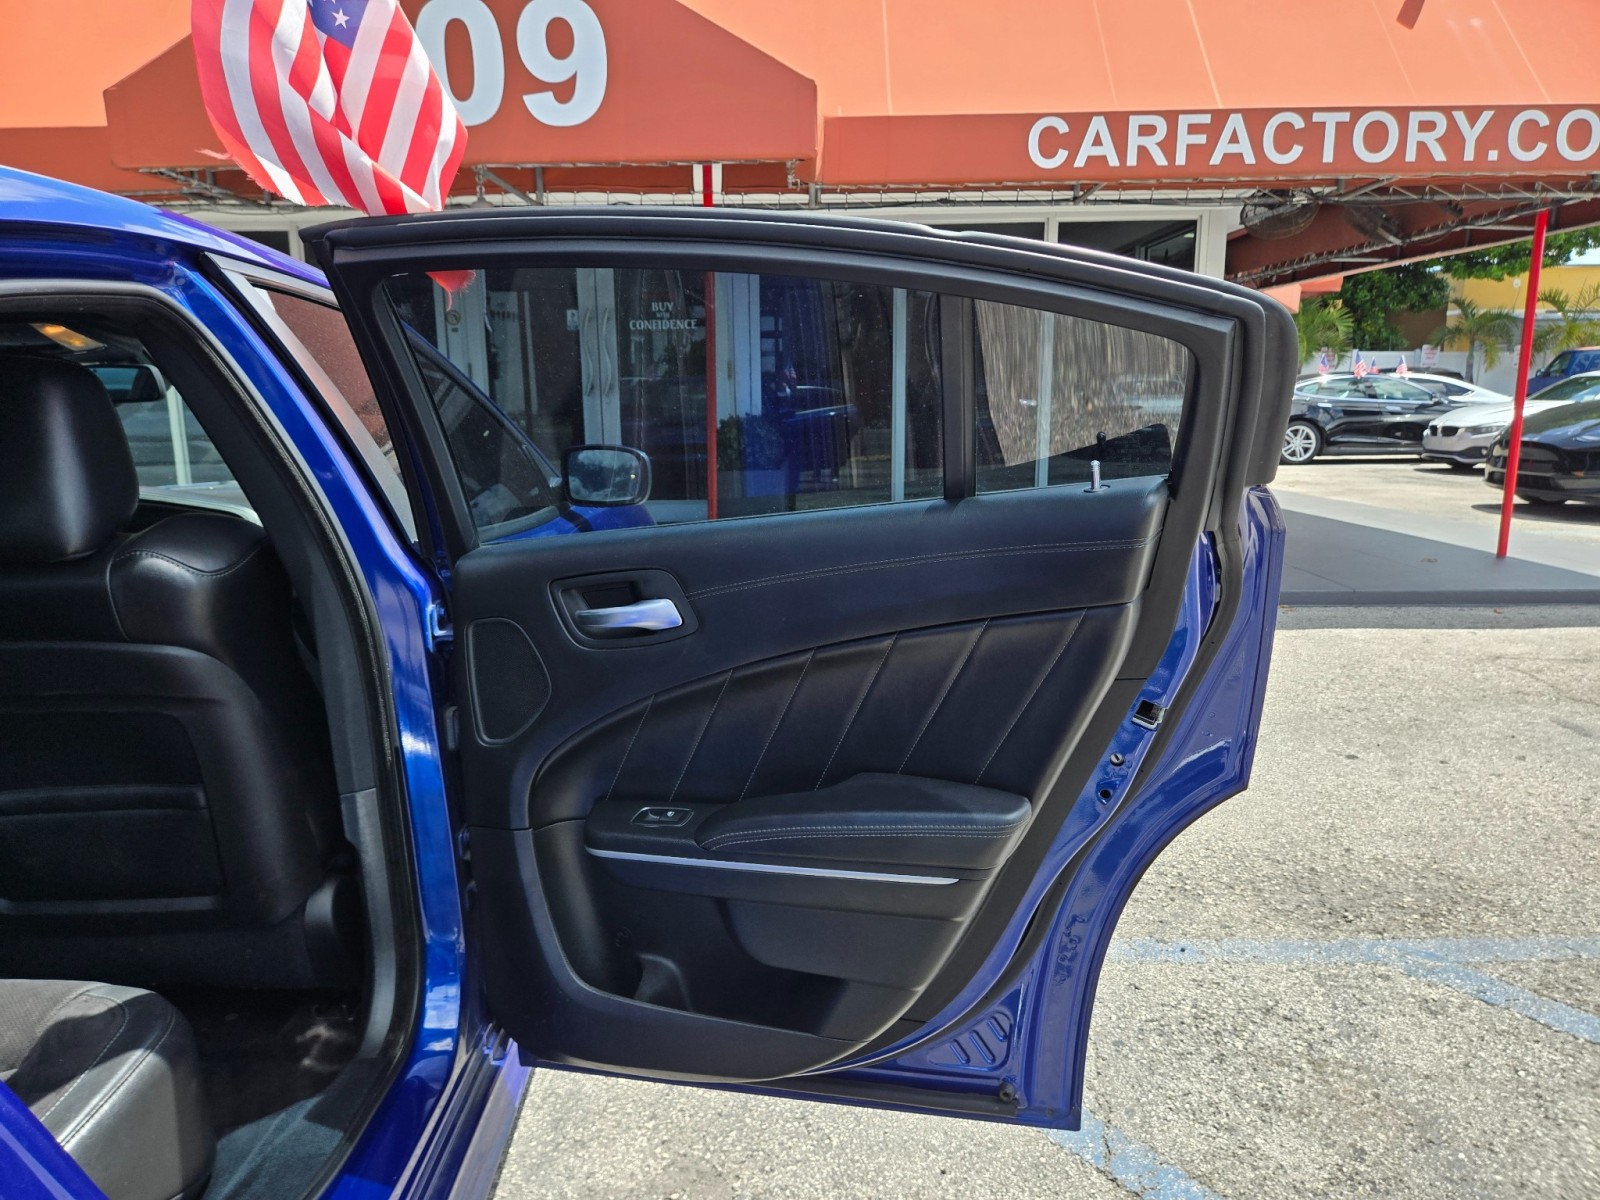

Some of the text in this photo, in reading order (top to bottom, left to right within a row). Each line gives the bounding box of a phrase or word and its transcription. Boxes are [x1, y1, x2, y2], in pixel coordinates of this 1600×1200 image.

[1027, 108, 1600, 169] CARFACTORY.CO
[651, 301, 674, 312] BUY
[628, 319, 698, 330] CONFIDENCE
